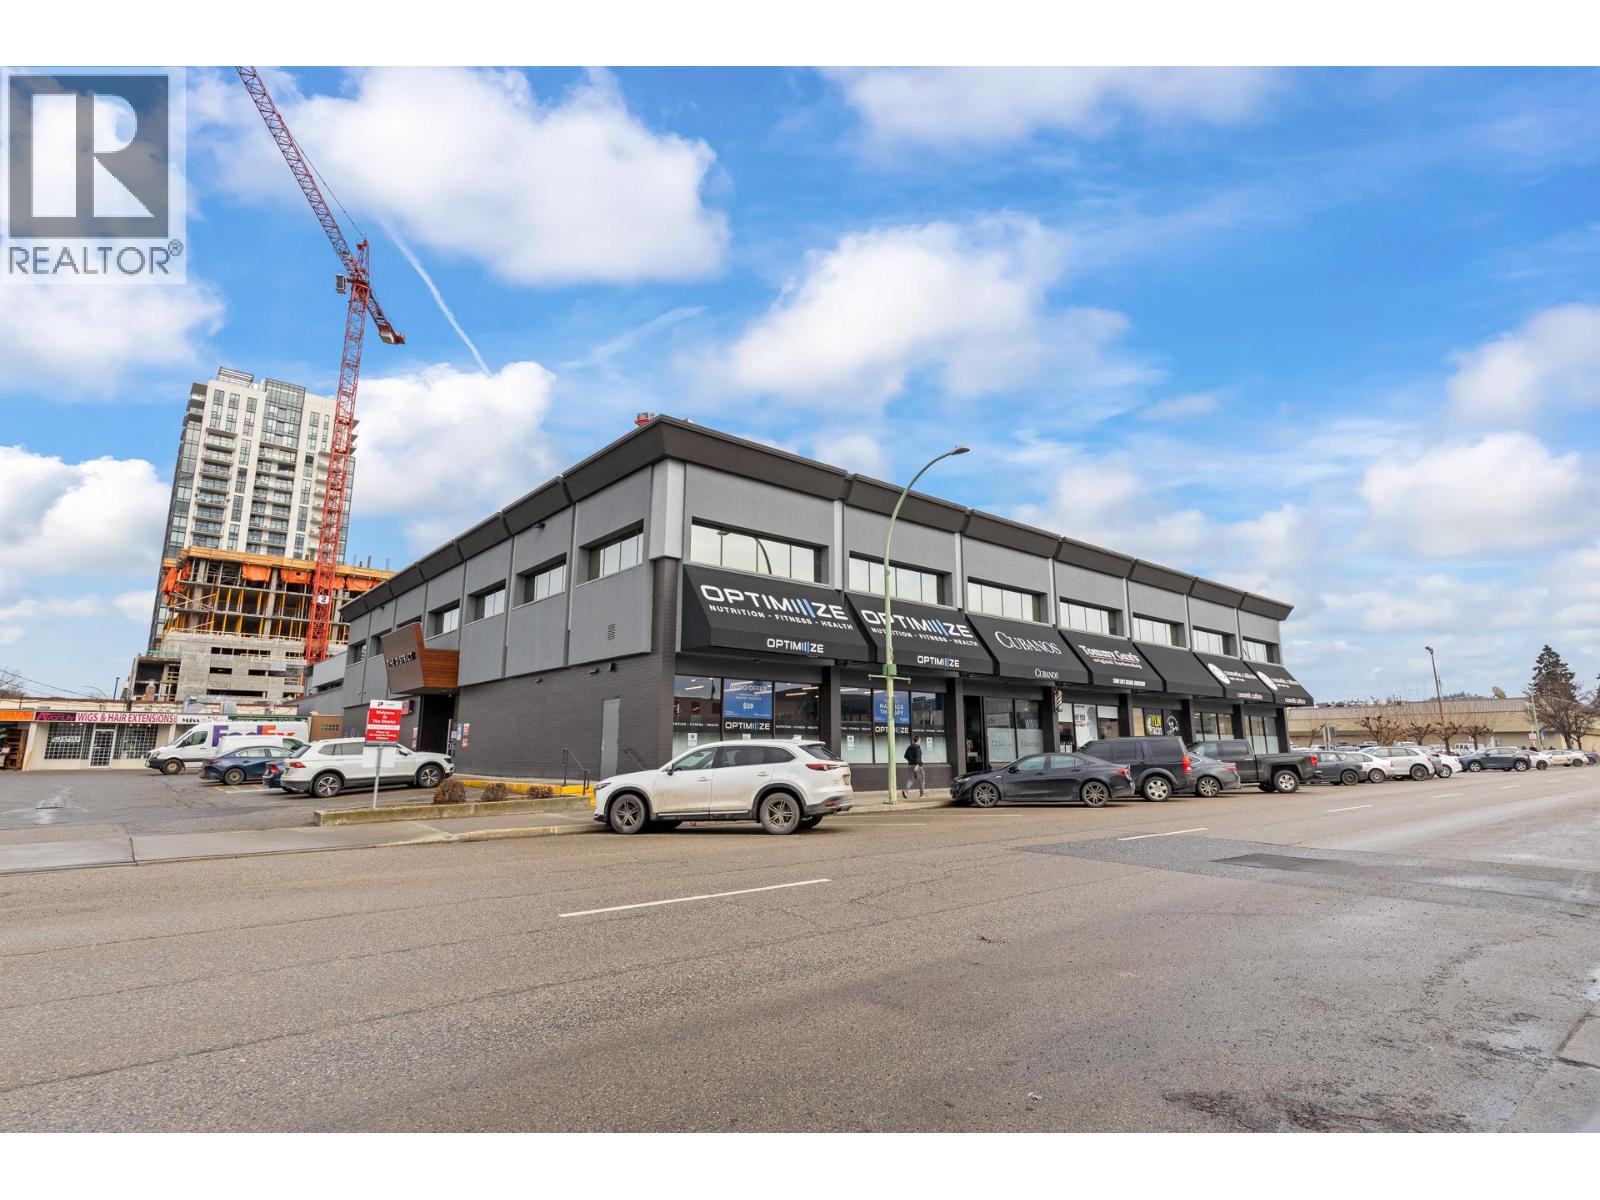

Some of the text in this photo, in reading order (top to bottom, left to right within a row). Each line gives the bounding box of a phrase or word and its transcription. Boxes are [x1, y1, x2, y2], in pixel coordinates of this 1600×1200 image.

[708, 604, 854, 630] NUTRITION FITNESS HEALTH
[871, 627, 979, 647] NUTITION FITNESS HEALTH
[100, 713, 106, 722] &
